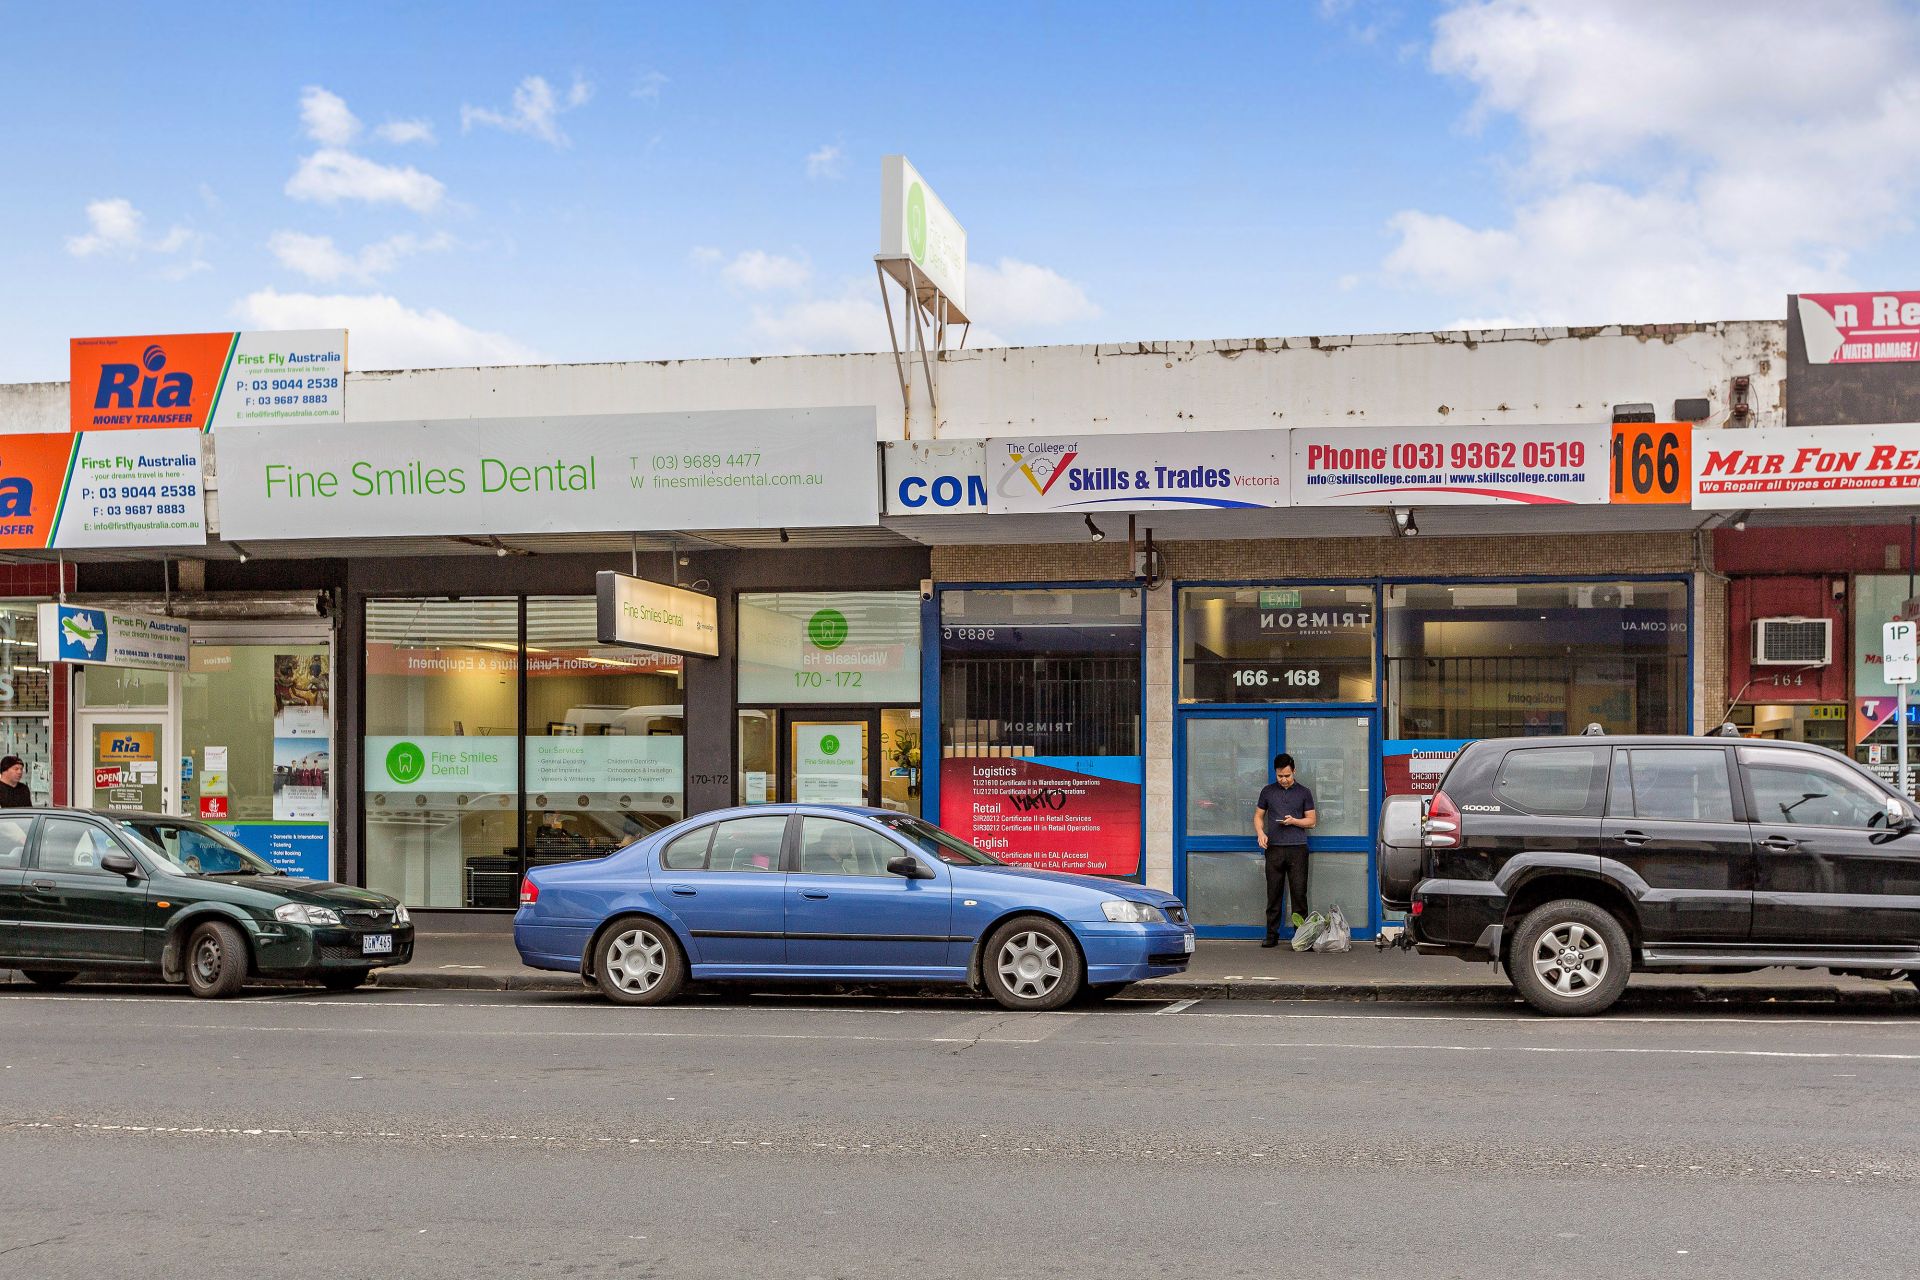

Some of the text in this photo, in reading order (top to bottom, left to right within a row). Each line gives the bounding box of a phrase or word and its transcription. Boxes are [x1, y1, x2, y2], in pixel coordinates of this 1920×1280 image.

[1872, 296, 1920, 326] Re
[1842, 342, 1912, 360] WATER DAMAGE
[237, 351, 341, 366] First Fly Australia
[263, 366, 285, 374] dreams
[94, 345, 195, 409] Ria
[237, 378, 338, 391] P: 03 9044 2538
[246, 394, 328, 406] F: 03 9687 8883
[93, 413, 193, 425] MONEY TRANSFER
[245, 408, 340, 419] info@firstflyaustralia.com.au
[1007, 442, 1078, 454] The College of
[629, 453, 761, 470] T (03) 9689 4477
[1308, 441, 1585, 470] Phone (03) 9362 0519
[1701, 445, 1920, 476] MAR FON RE
[81, 454, 196, 471] First Fly Australia
[1613, 432, 1680, 494] 166
[94, 473, 110, 481] your
[111, 472, 136, 480] dreams
[138, 471, 156, 479] travel
[165, 470, 181, 478] here
[265, 456, 596, 498] Fine Smiles Dental
[630, 473, 823, 489] W finesmilesdental.com.au
[1068, 466, 1280, 491] Skills & Trades Victoria
[1307, 471, 1586, 486] info@skillscollege.com.au www.skillscollege.com.au
[1702, 476, 1898, 493] We Repair all types of Phones &
[82, 485, 196, 500] P: 03 9044 2538
[93, 504, 185, 516] F: 03 9687 8883
[84, 521, 199, 531] E: info@firstflyaustralia.com.au
[1269, 593, 1290, 606] EXIT
[623, 601, 684, 627] Fine Smiles Dental
[112, 616, 187, 634] First Fly Australia
[1890, 626, 1909, 640] 1P
[116, 678, 140, 688] 174
[794, 672, 863, 688] 170 172
[1232, 669, 1320, 686] 166 168
[1772, 675, 1803, 686] 164
[111, 735, 140, 753] Ria
[431, 751, 498, 763] Fine Smiles
[431, 765, 469, 775] Dental
[973, 766, 1017, 777] Logistics
[97, 772, 119, 783] OPEN
[117, 771, 137, 783] 174
[690, 775, 729, 785] 170-172
[1038, 779, 1071, 787] Warehousing
[973, 803, 1001, 813] Retail
[201, 811, 227, 819] Emirates
[973, 824, 1000, 832] SIR30212
[1001, 824, 1032, 832] Certificate
[1067, 824, 1101, 832] Operations
[973, 837, 1009, 849] English
[1001, 851, 1032, 859] Certificate
[1062, 851, 1088, 859] (Access)
[1087, 861, 1106, 869] Study)
